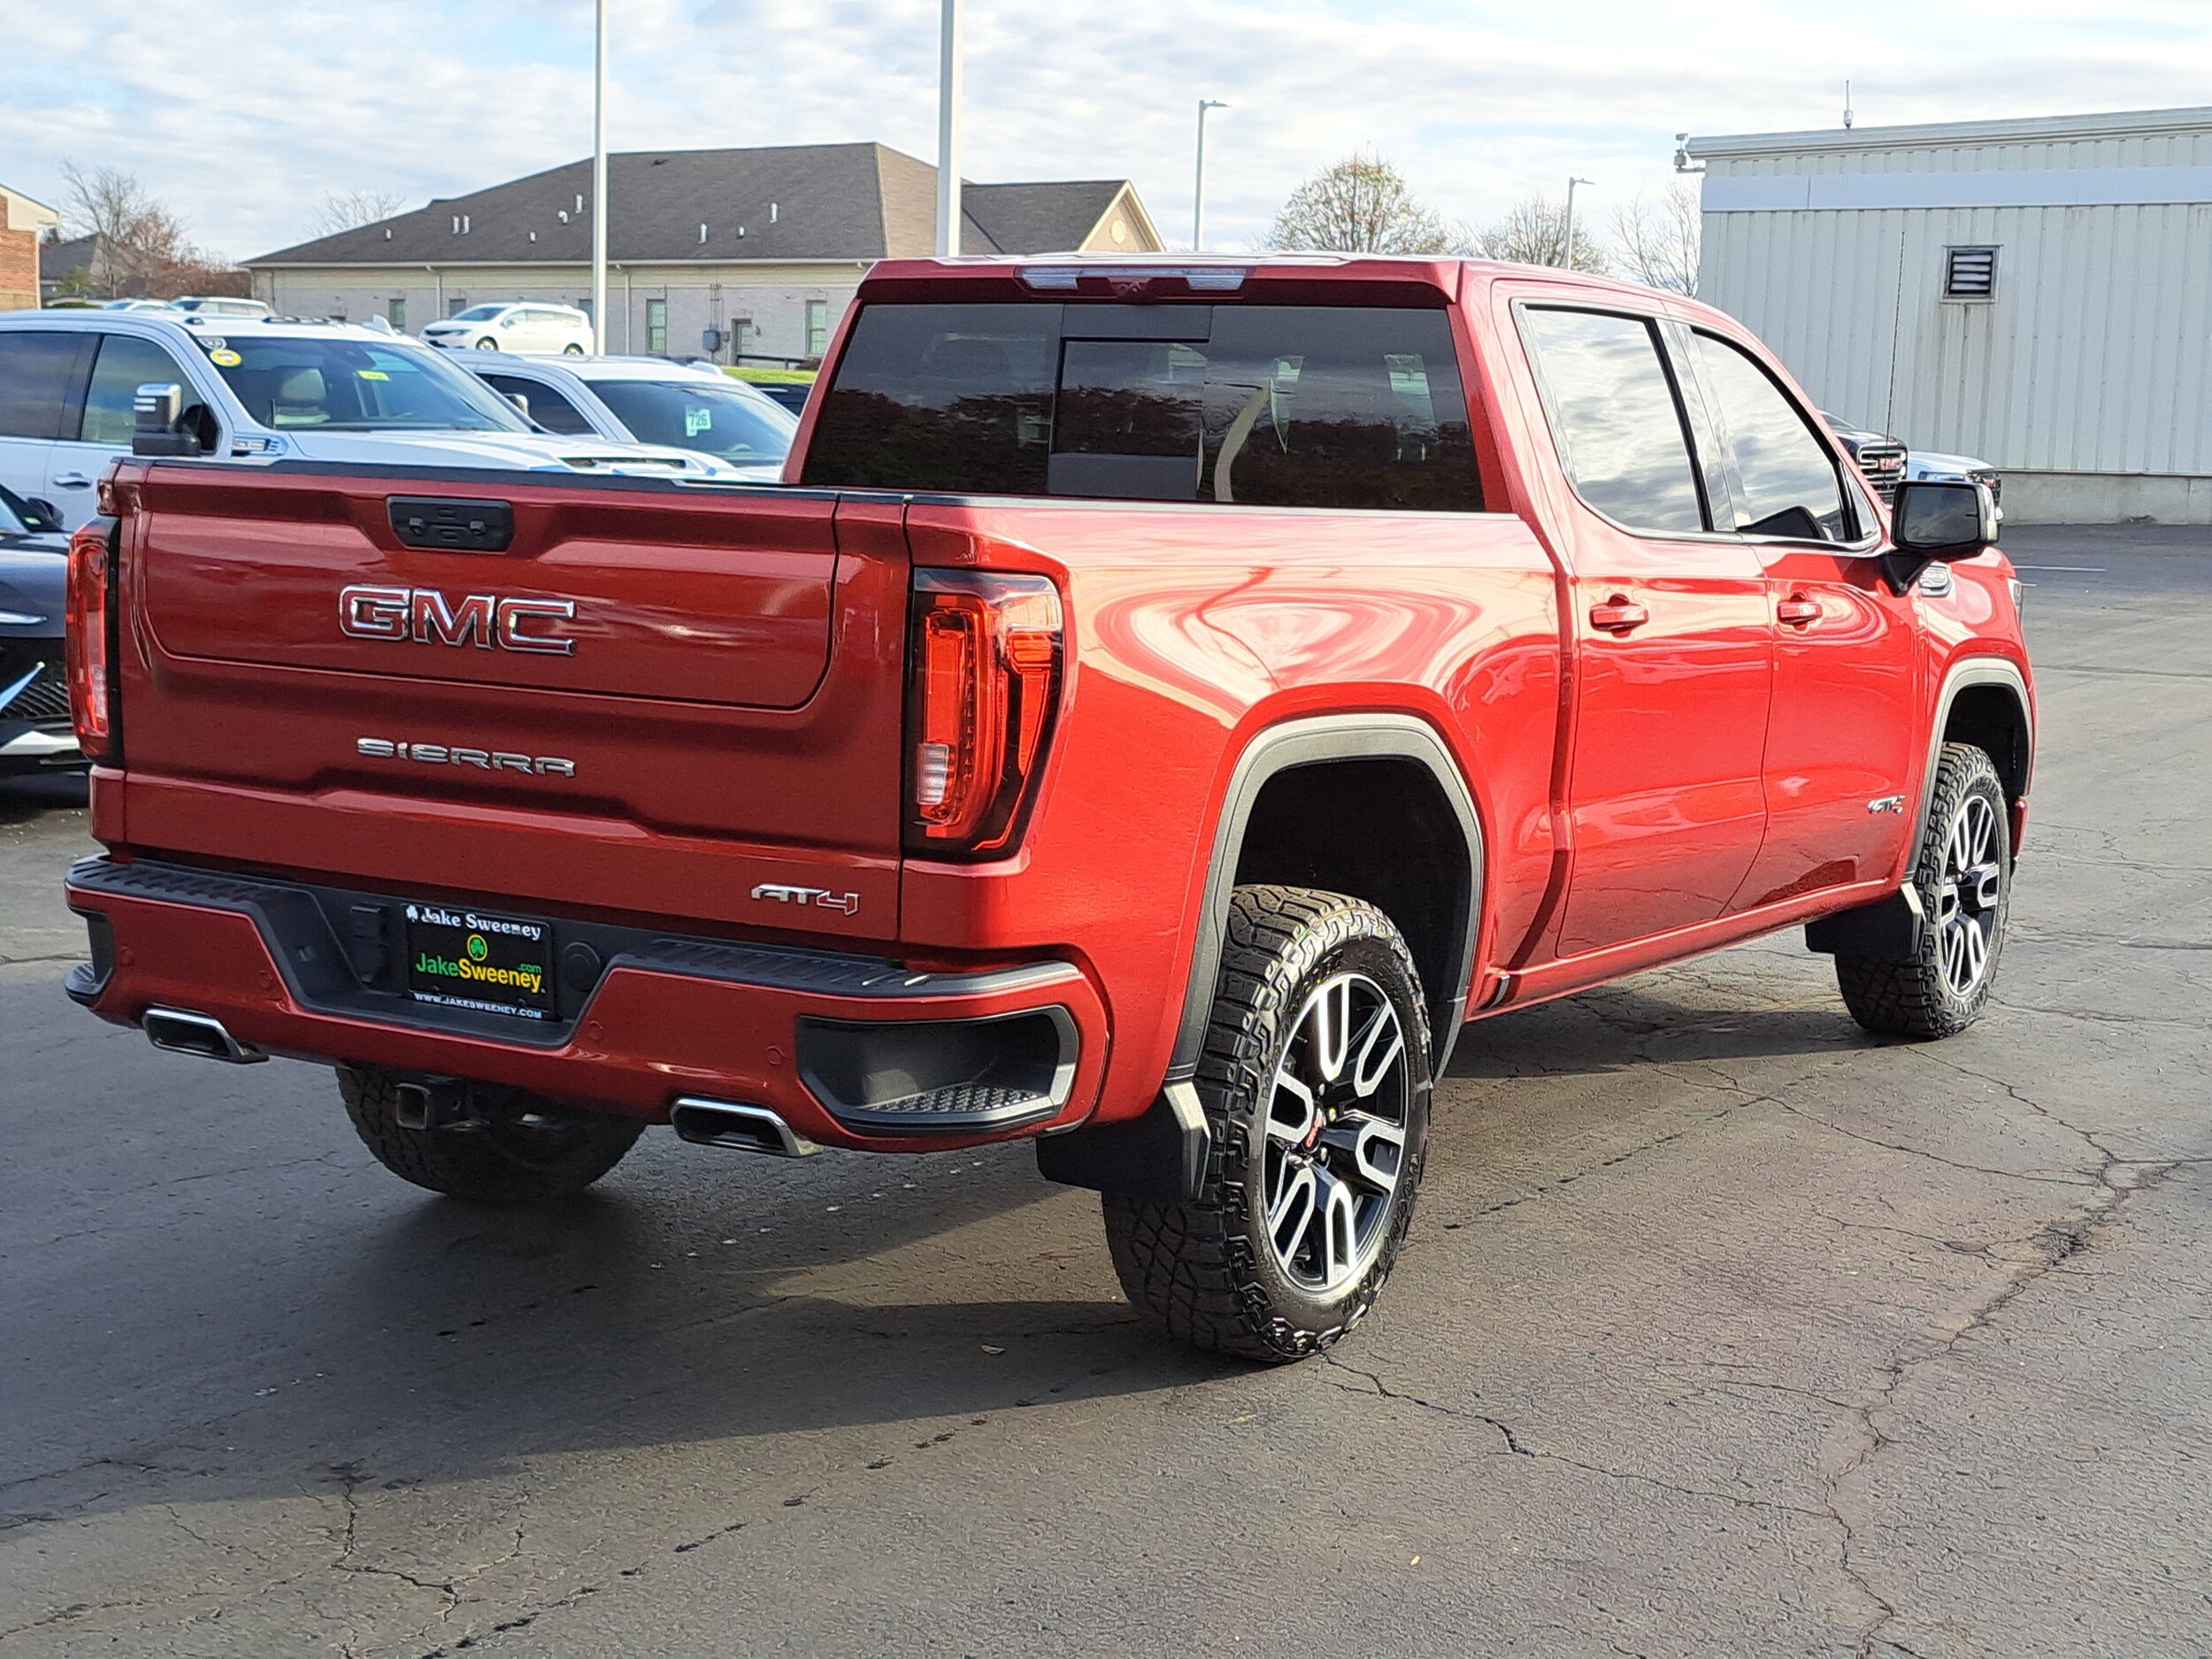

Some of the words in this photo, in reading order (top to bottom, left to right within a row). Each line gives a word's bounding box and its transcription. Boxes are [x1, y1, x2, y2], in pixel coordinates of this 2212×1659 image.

[339, 584, 578, 657] GMC
[356, 736, 577, 779] SIERRA
[750, 883, 862, 917] AT4
[421, 907, 461, 926] Jake
[465, 914, 541, 941] Sweeney
[414, 993, 542, 1018] WWW.JAKESWEENEY.COM
